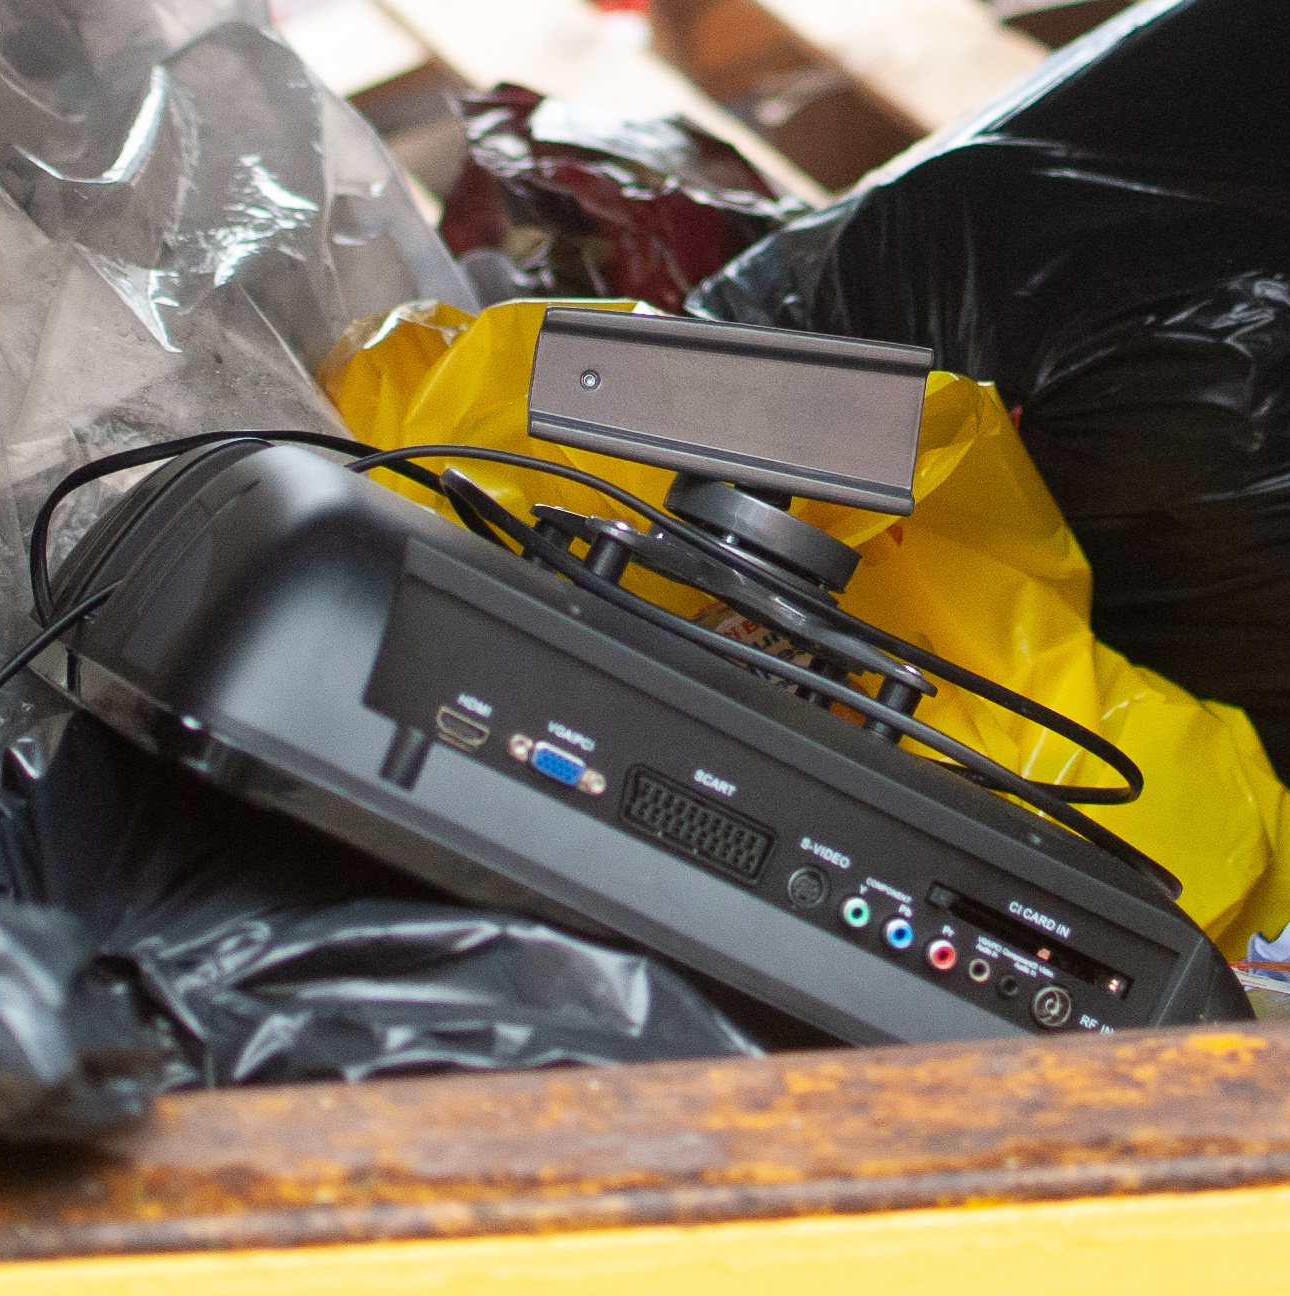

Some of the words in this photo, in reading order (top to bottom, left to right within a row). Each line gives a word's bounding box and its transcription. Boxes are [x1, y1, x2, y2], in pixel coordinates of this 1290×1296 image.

[694, 769, 737, 796] SCART
[800, 837, 851, 869] S-VIDEO
[1009, 901, 1023, 915] CI
[1023, 908, 1056, 931] CARD
[1055, 923, 1071, 939] IN
[1079, 1014, 1098, 1029] RF
